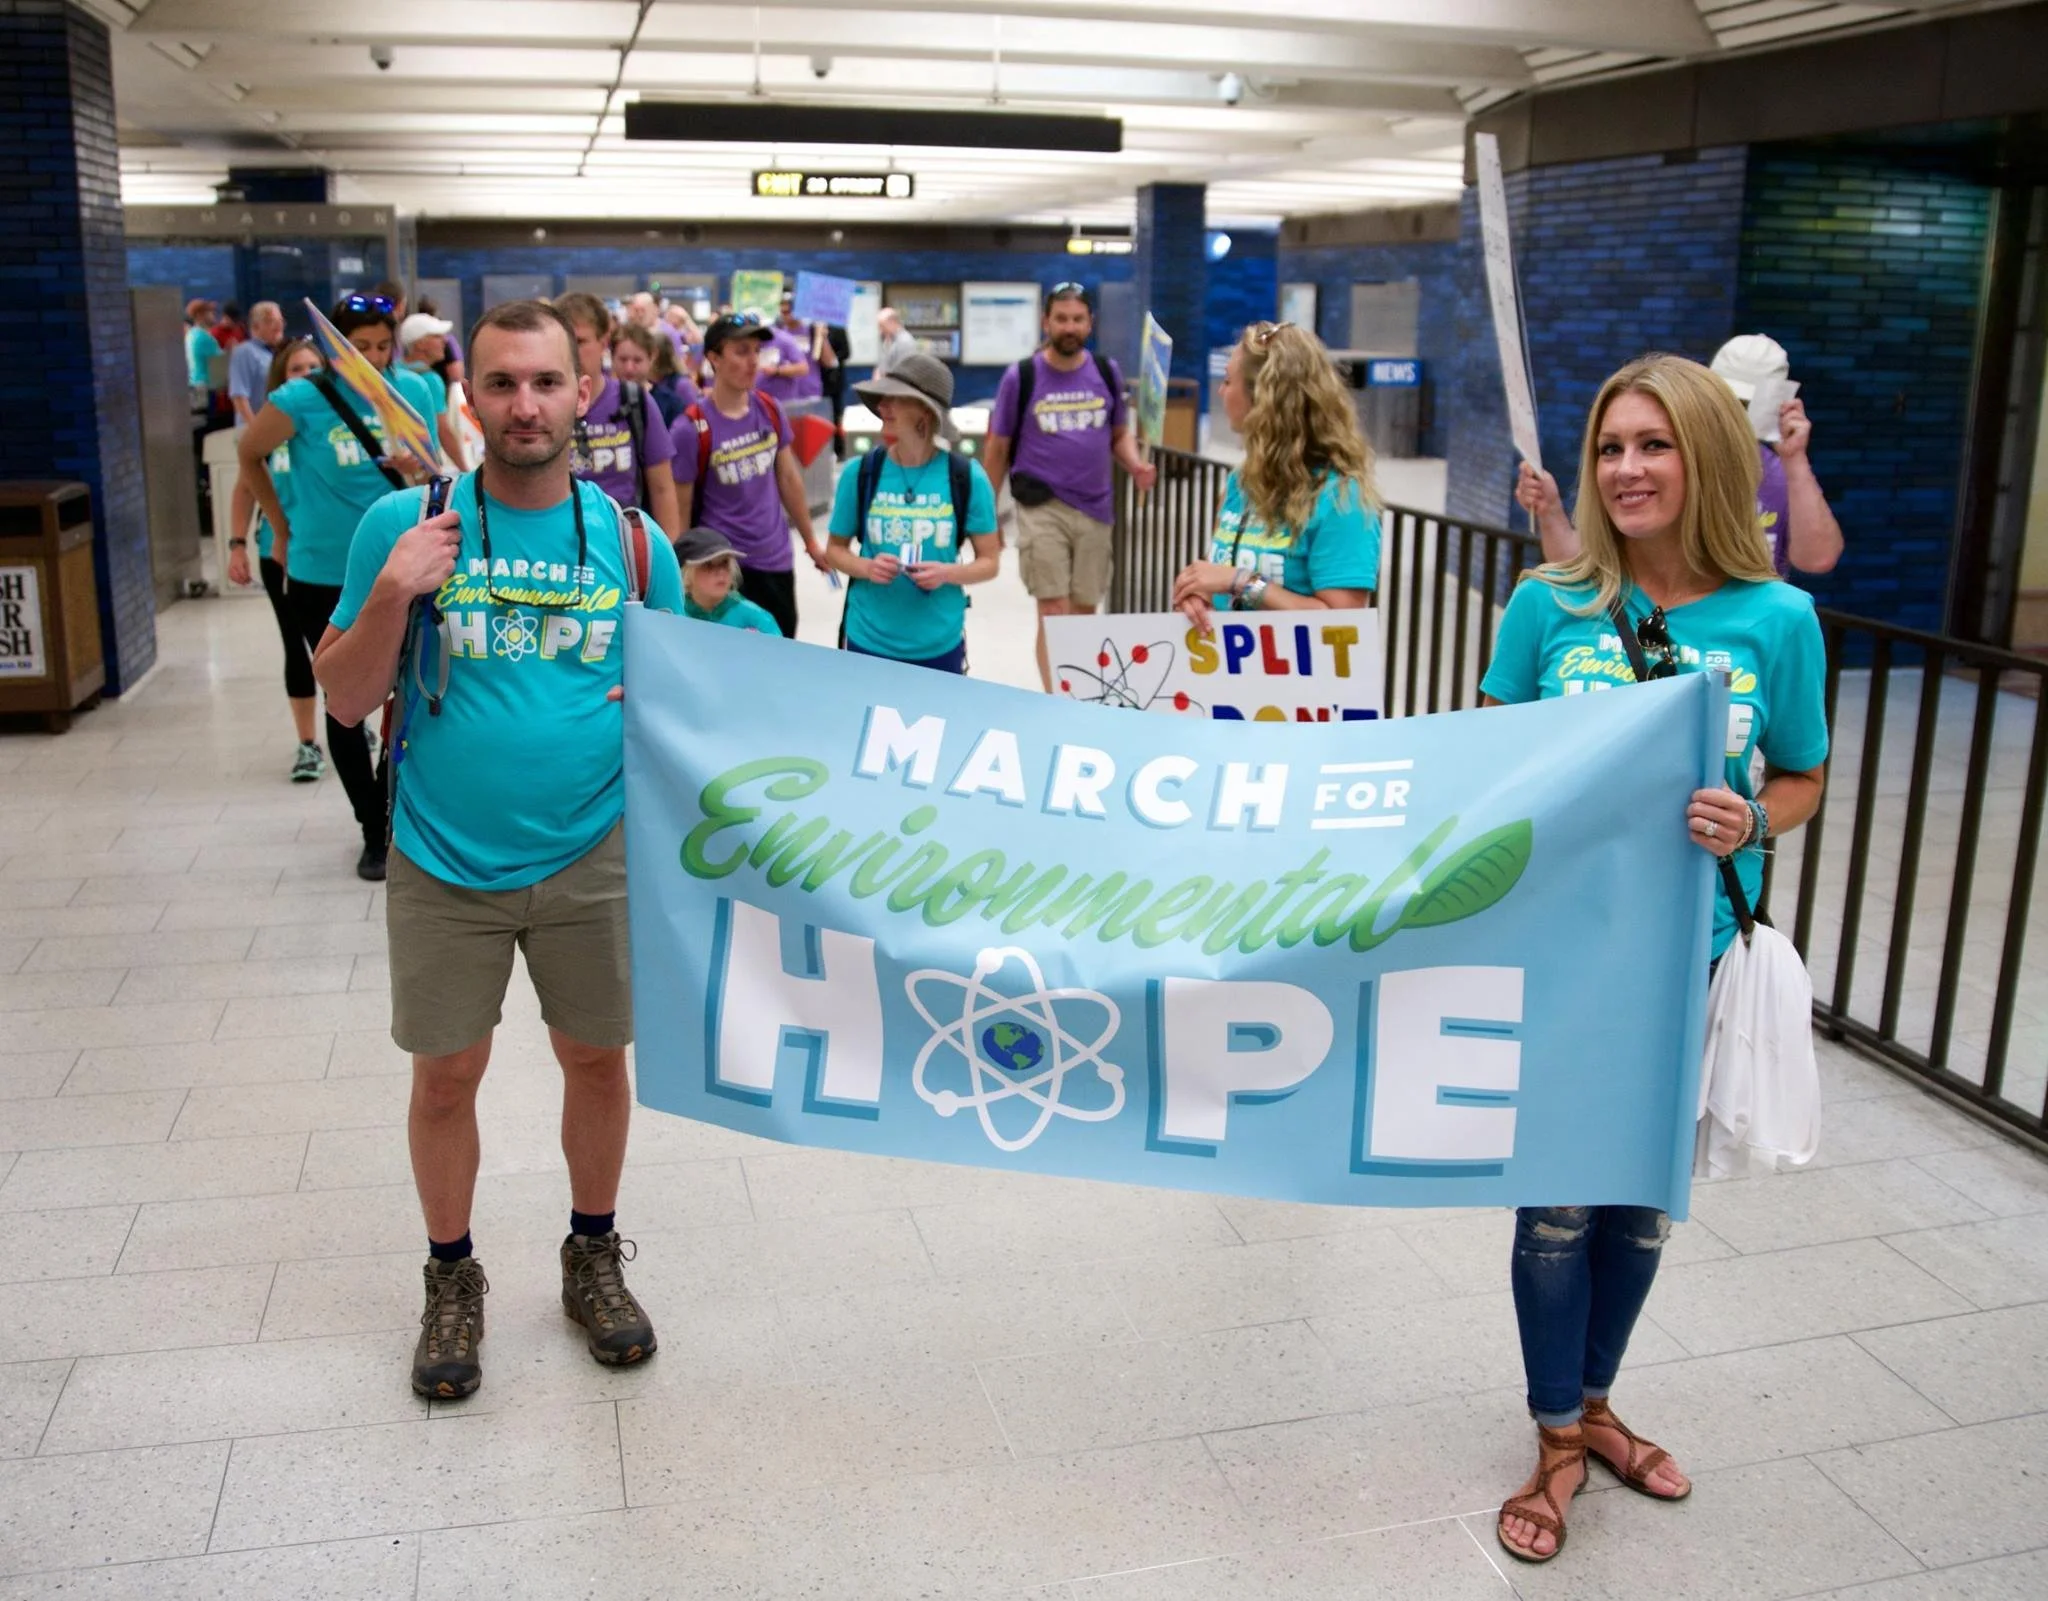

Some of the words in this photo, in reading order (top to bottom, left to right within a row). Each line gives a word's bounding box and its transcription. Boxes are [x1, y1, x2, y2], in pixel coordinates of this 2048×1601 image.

[1373, 362, 1416, 382] NEWS
[435, 574, 606, 613] Environmental
[469, 558, 568, 582] MARCH
[445, 609, 618, 663] HOPE
[1185, 624, 1359, 678] SPLIT
[854, 705, 1288, 831] MARCH
[1312, 778, 1411, 812] FOR
[680, 755, 1470, 954] Environmental
[705, 897, 1525, 1177] HOPE
